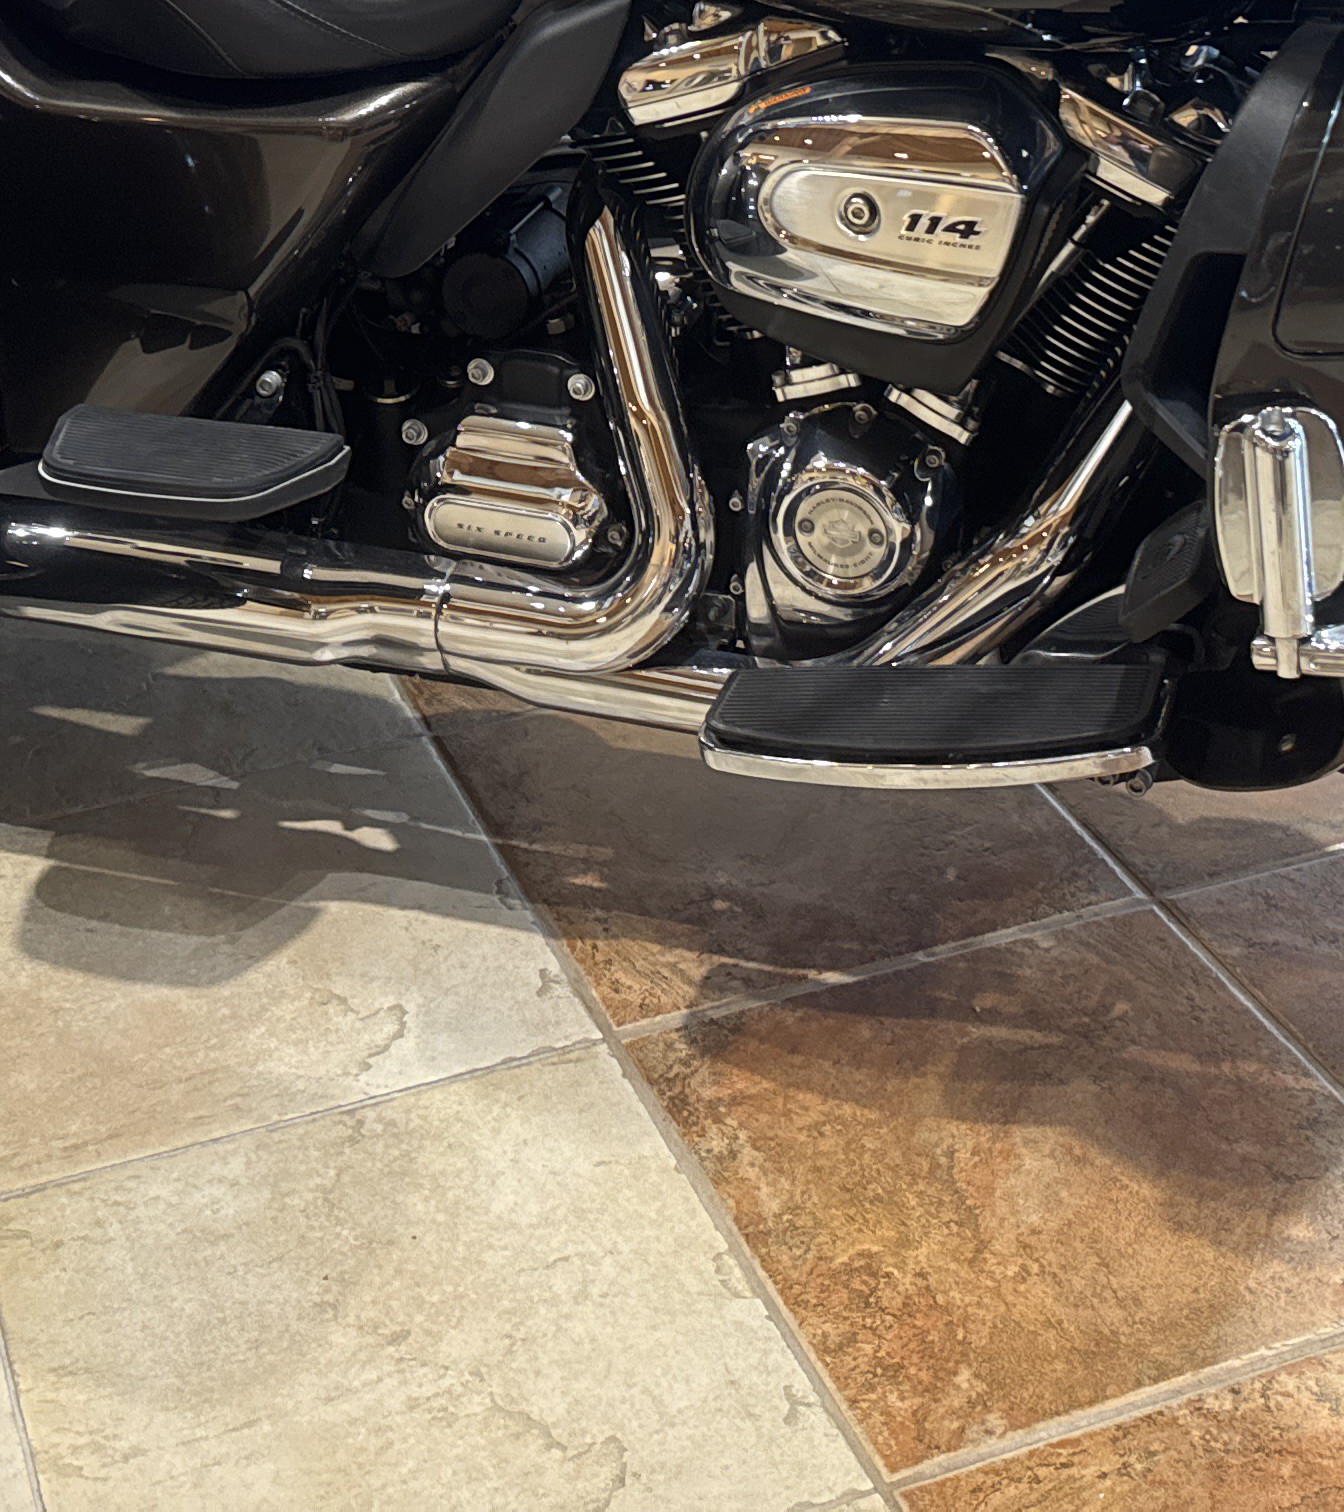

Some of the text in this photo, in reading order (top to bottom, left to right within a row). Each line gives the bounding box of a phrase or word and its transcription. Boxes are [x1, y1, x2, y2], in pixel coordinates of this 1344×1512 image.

[902, 211, 985, 240] 114
[897, 233, 982, 251] CUBIC INCHES
[493, 529, 547, 544] SPEED
